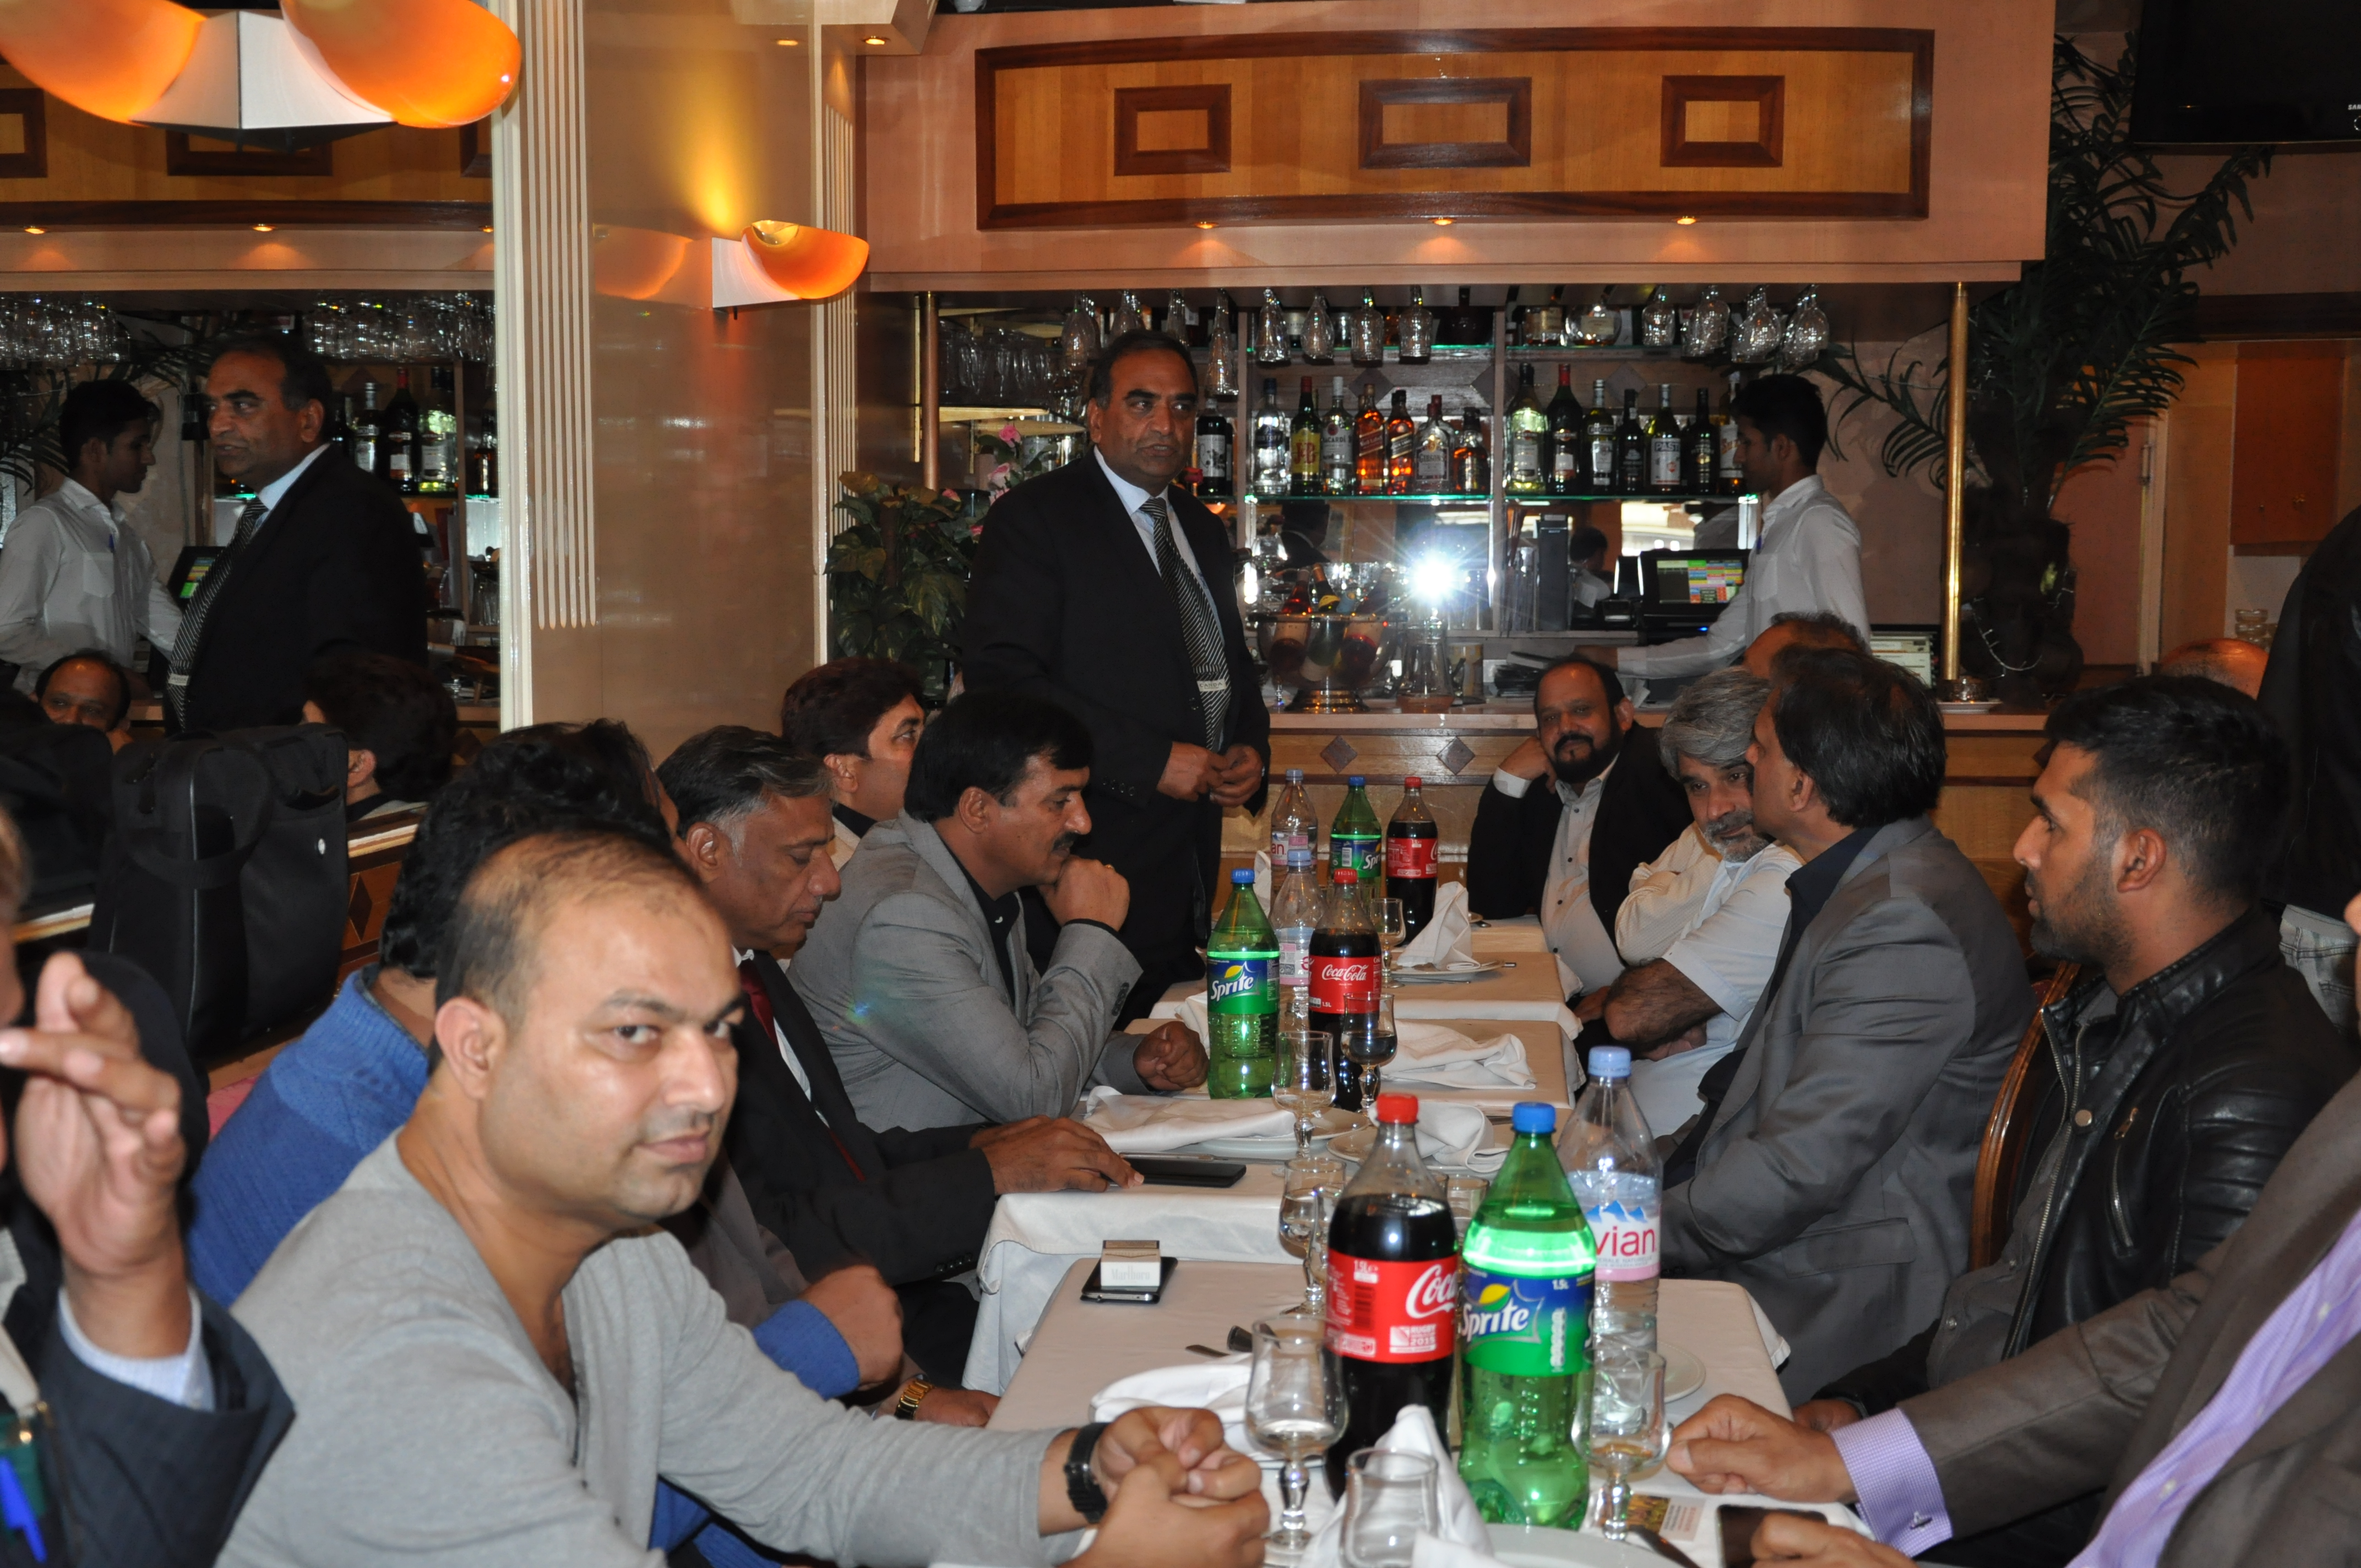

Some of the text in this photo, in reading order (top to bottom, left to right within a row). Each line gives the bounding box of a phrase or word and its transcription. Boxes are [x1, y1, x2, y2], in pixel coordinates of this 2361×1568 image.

[1210, 971, 1254, 1002] Sprite
[1321, 964, 1369, 982] Coca-Cola
[1596, 1226, 1655, 1256] vian
[1111, 1265, 1150, 1281] Marlboro
[1461, 1297, 1530, 1342] Sprite
